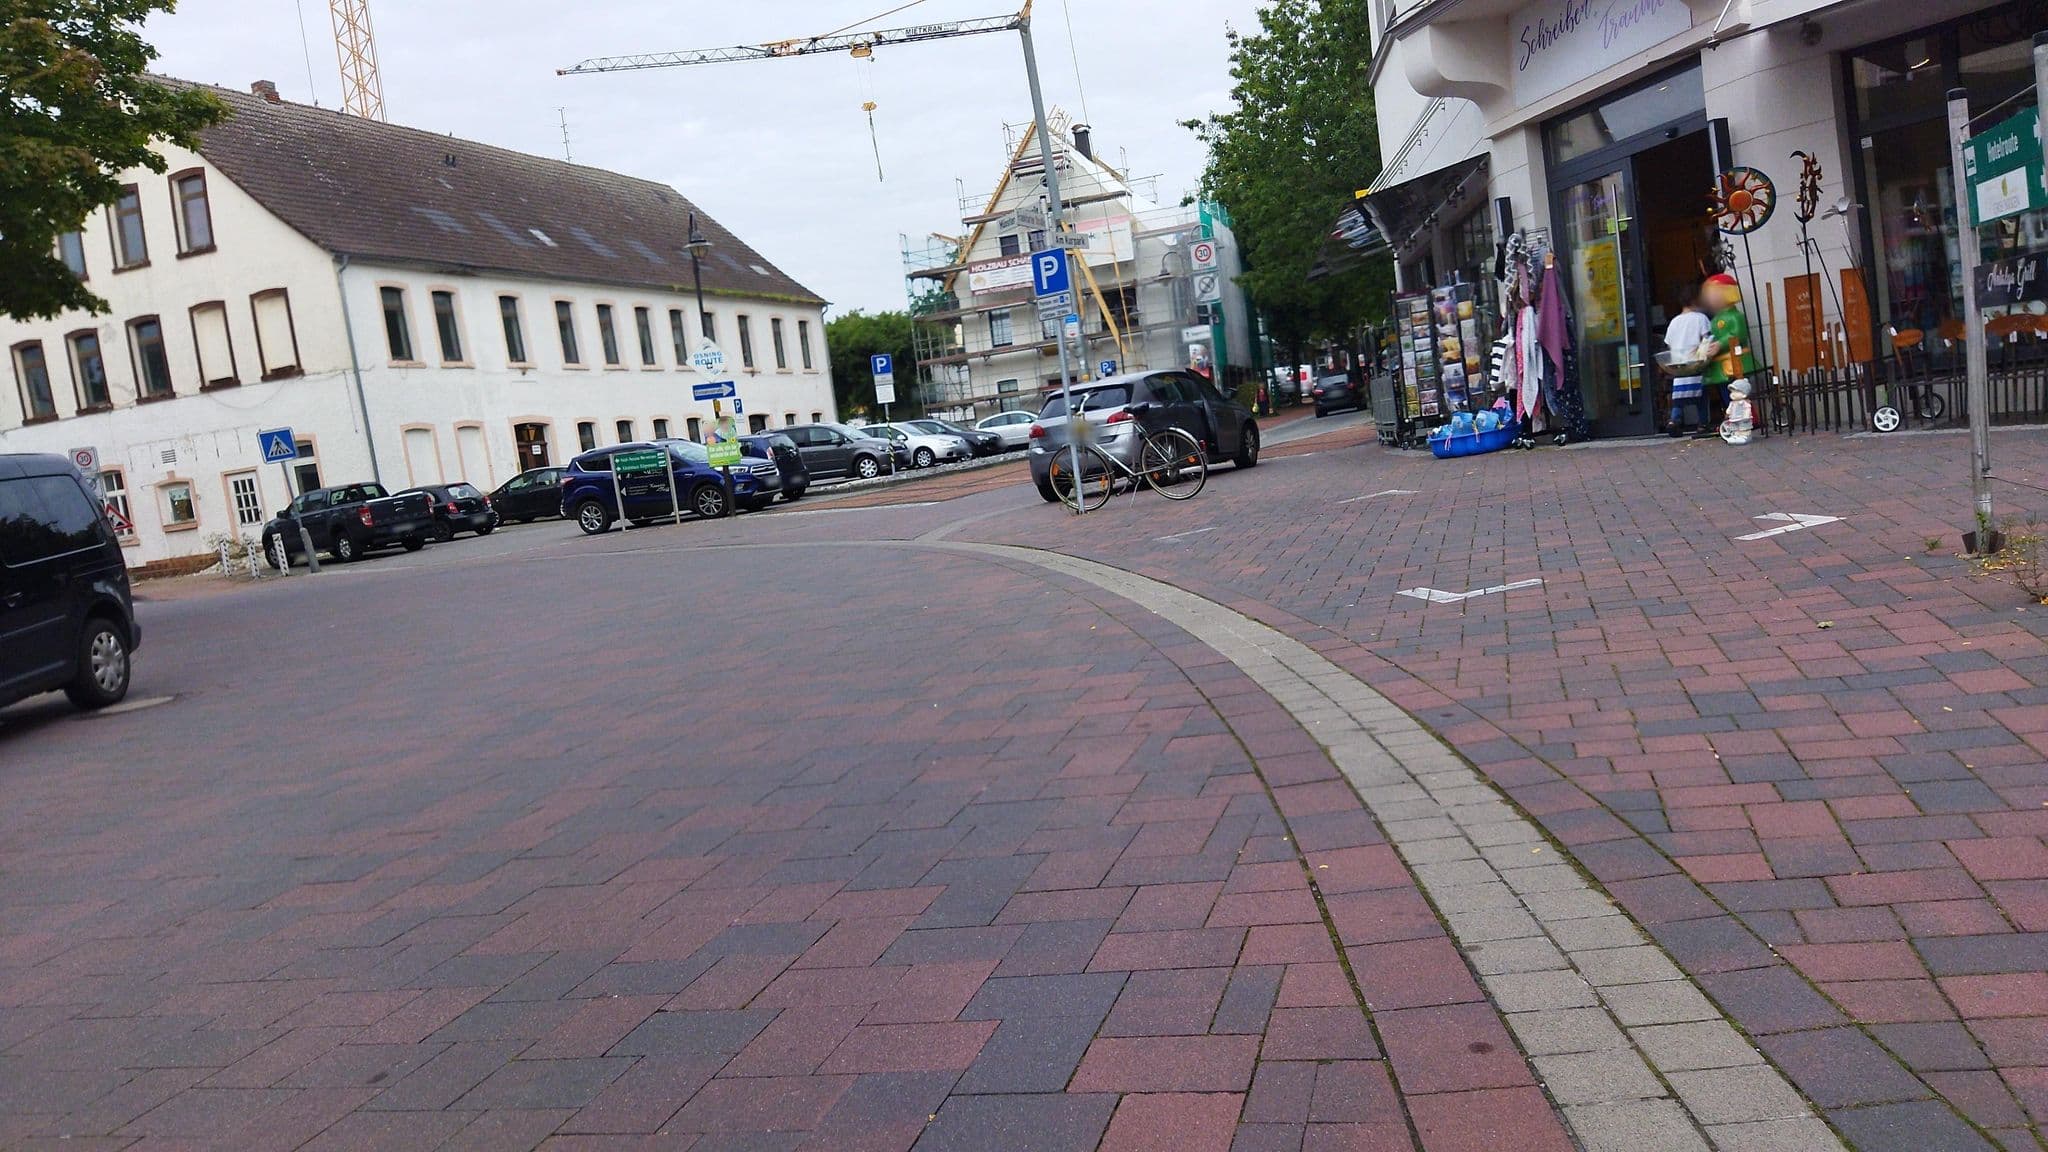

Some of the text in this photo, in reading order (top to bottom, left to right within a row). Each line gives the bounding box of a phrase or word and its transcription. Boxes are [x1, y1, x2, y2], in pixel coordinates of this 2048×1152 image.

[904, 24, 943, 36] MIETKRAN
[1986, 132, 2019, 163] Hotelroute
[1198, 248, 1208, 258] 30
[971, 260, 1008, 273] HOLZBAU
[1039, 255, 1059, 289] P
[693, 351, 722, 360] OSNING
[695, 358, 724, 366] ROUTE
[876, 357, 887, 372] P
